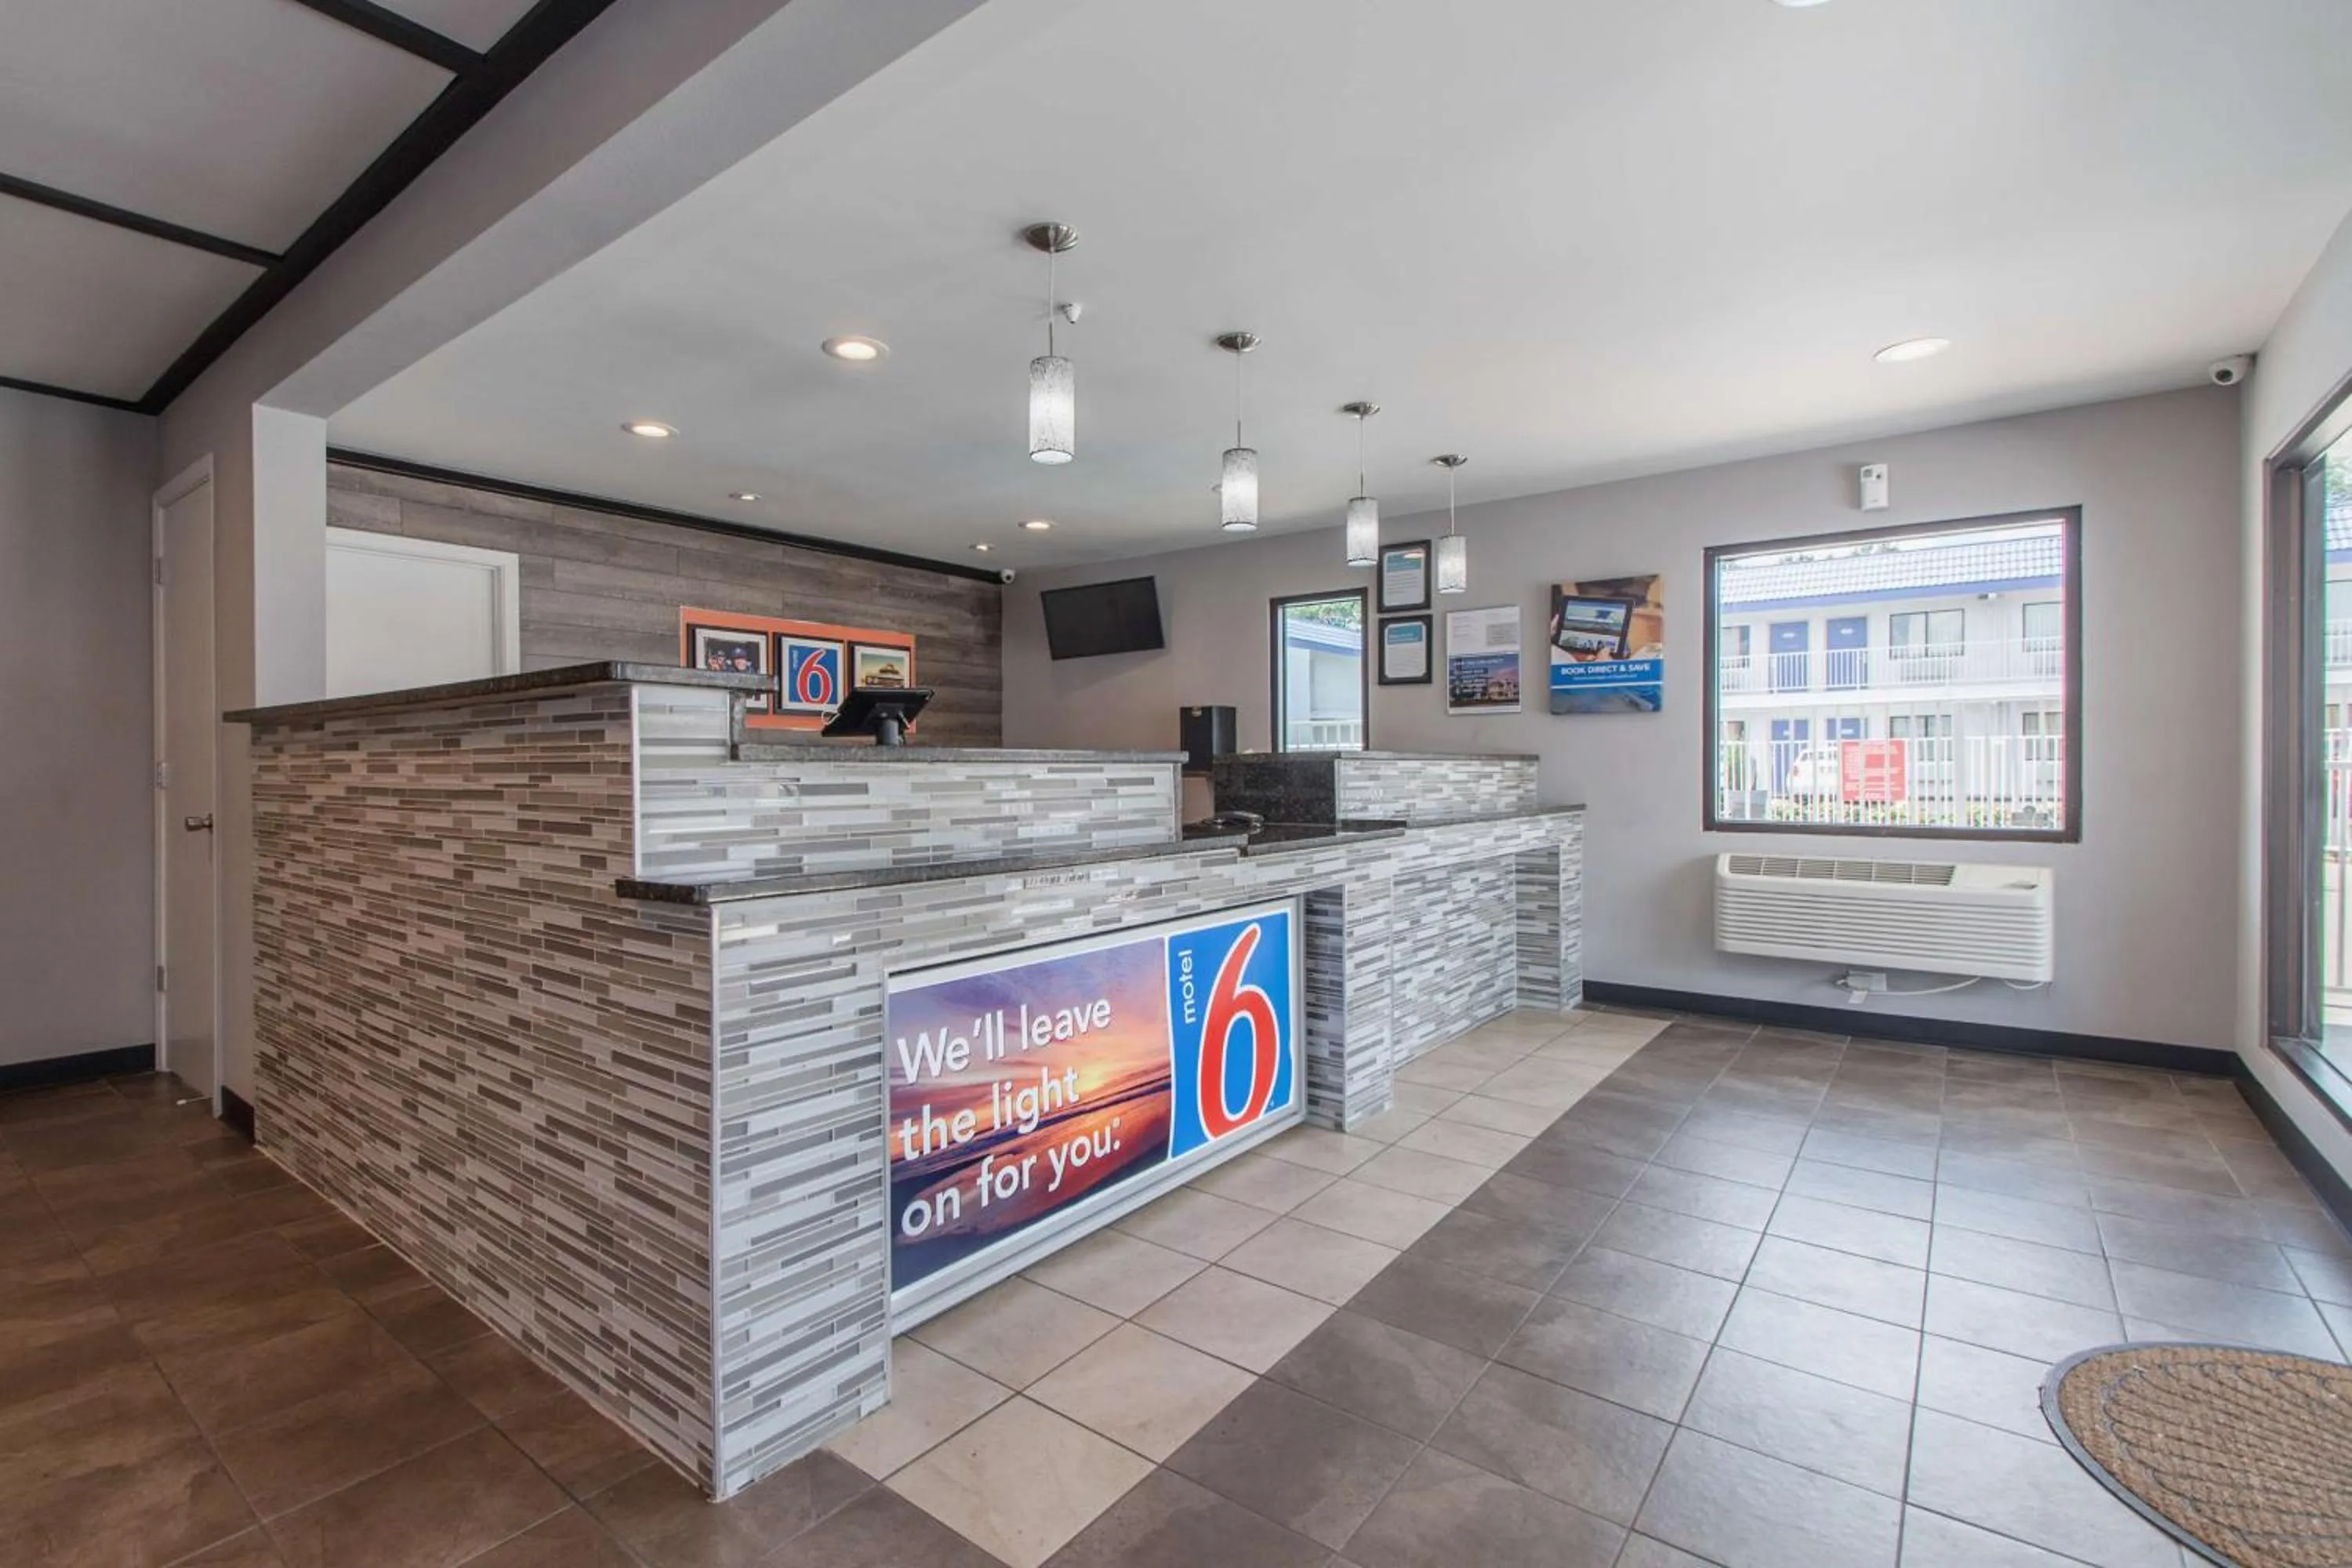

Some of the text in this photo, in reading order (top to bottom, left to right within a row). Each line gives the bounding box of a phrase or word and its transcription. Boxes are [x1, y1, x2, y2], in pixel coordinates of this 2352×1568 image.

[797, 648, 833, 704] 6
[1588, 665, 1617, 673] DIRECT
[1628, 662, 1650, 671] SAVE
[896, 998, 1111, 1084] We'll leave
[1178, 922, 1280, 1142] motel 6
[899, 1065, 1080, 1161] the light
[902, 1186, 961, 1237] on
[976, 1155, 1038, 1207] for
